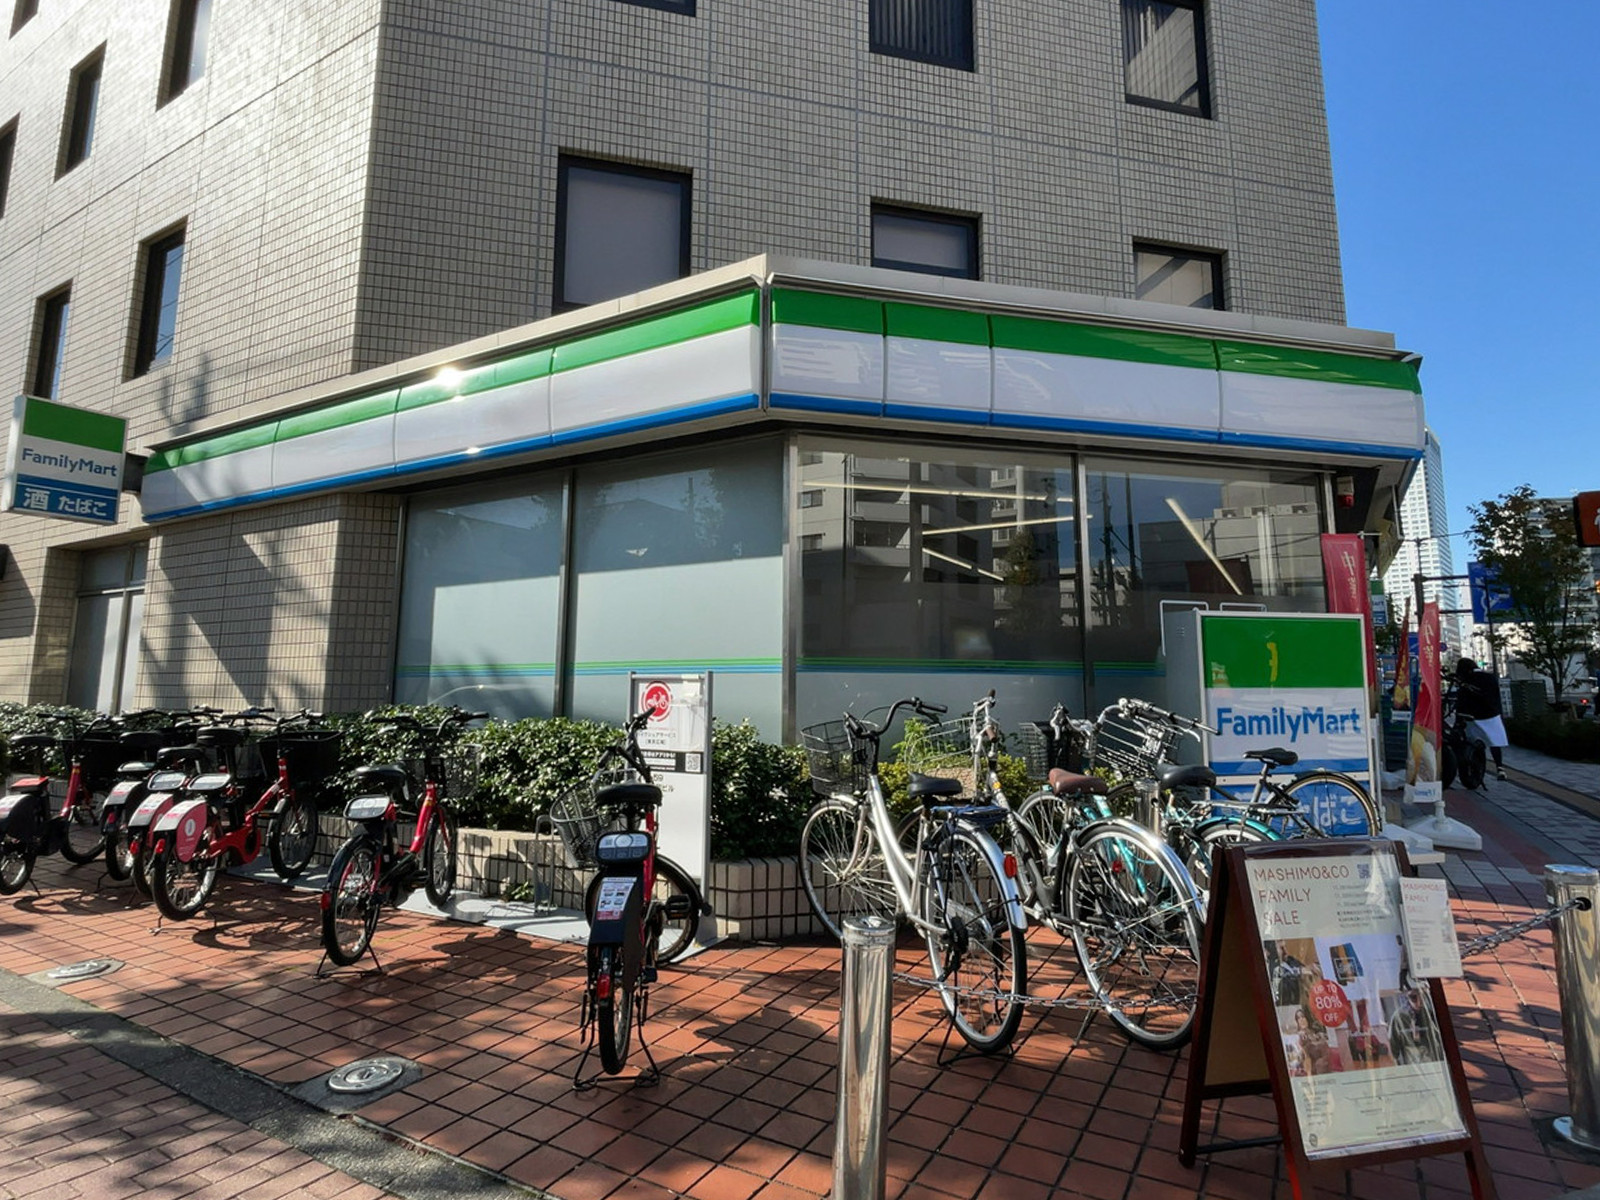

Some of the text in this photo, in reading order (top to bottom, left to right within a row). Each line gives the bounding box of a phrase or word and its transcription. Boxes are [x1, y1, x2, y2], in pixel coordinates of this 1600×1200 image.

[22, 448, 118, 477] FamilyMart
[23, 487, 107, 517] 酒 たばこ
[1217, 706, 1361, 743] FamilyMart
[1254, 864, 1350, 882] MASHIMO&CO
[1258, 888, 1311, 903] FAMILY
[1263, 909, 1301, 926] SALE
[1315, 995, 1342, 1009] 80%
[1323, 1013, 1339, 1023] OFF
